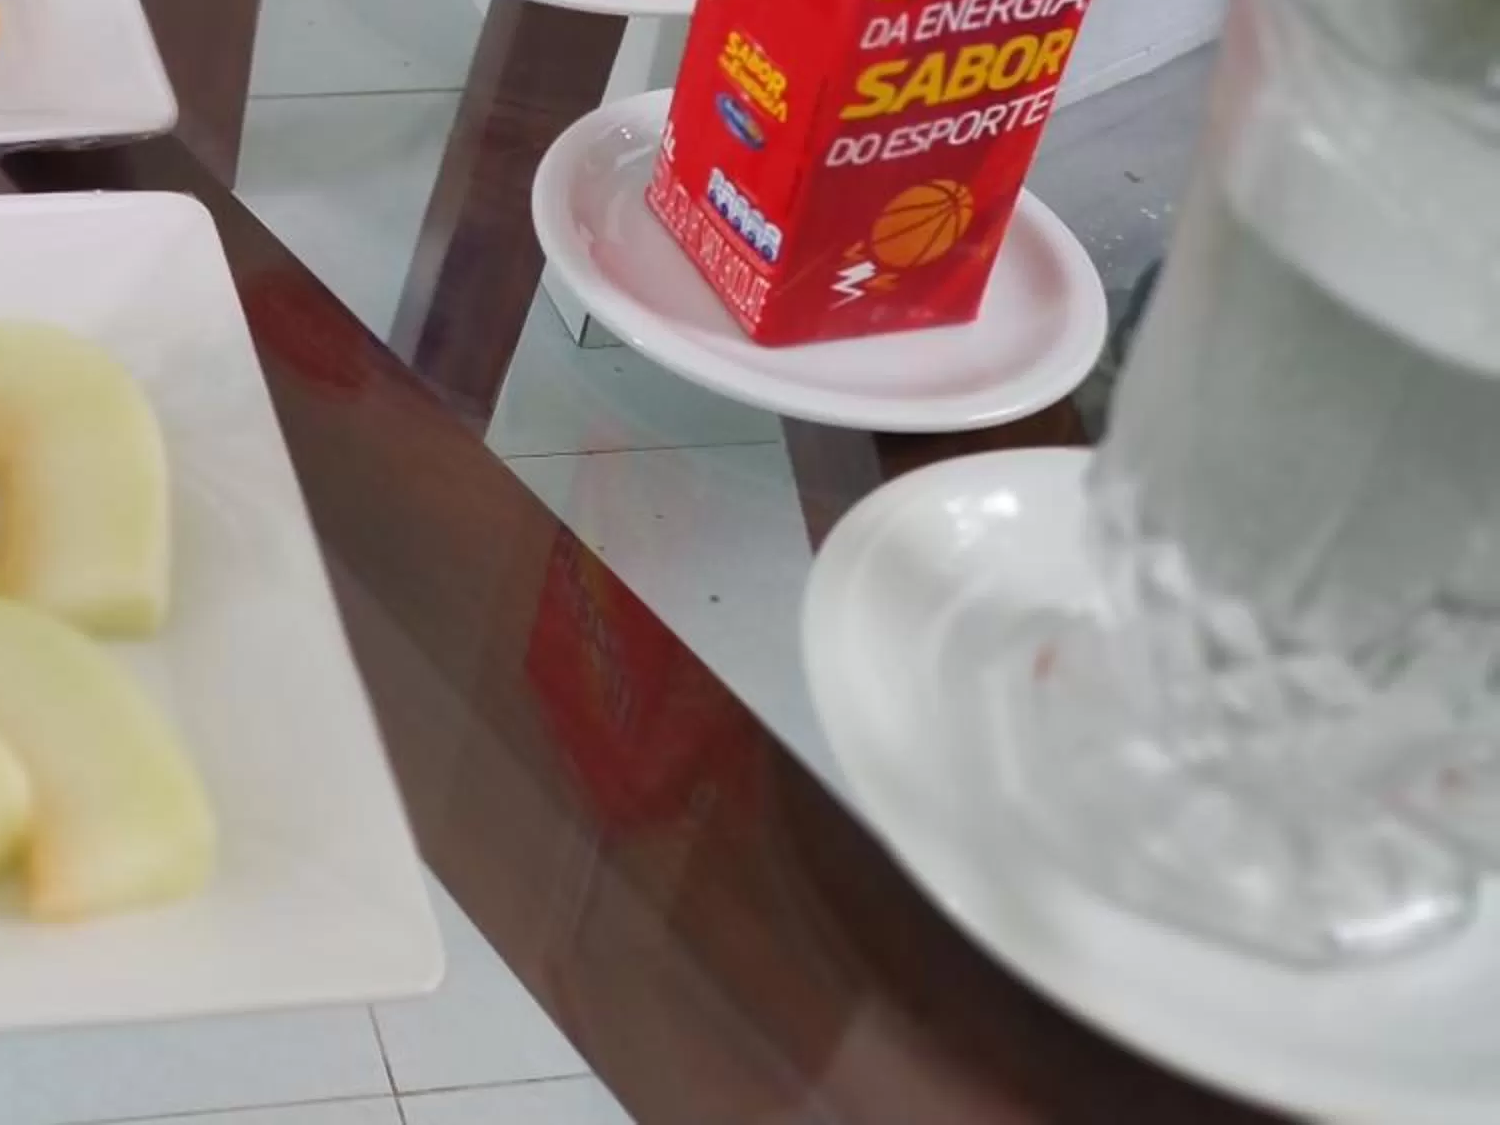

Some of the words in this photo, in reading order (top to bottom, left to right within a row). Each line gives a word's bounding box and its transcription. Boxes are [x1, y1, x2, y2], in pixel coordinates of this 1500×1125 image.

[860, 11, 909, 50] DA
[839, 28, 1076, 120] SABOR
[825, 134, 881, 167] DO
[880, 86, 1058, 161] ESPORTE
